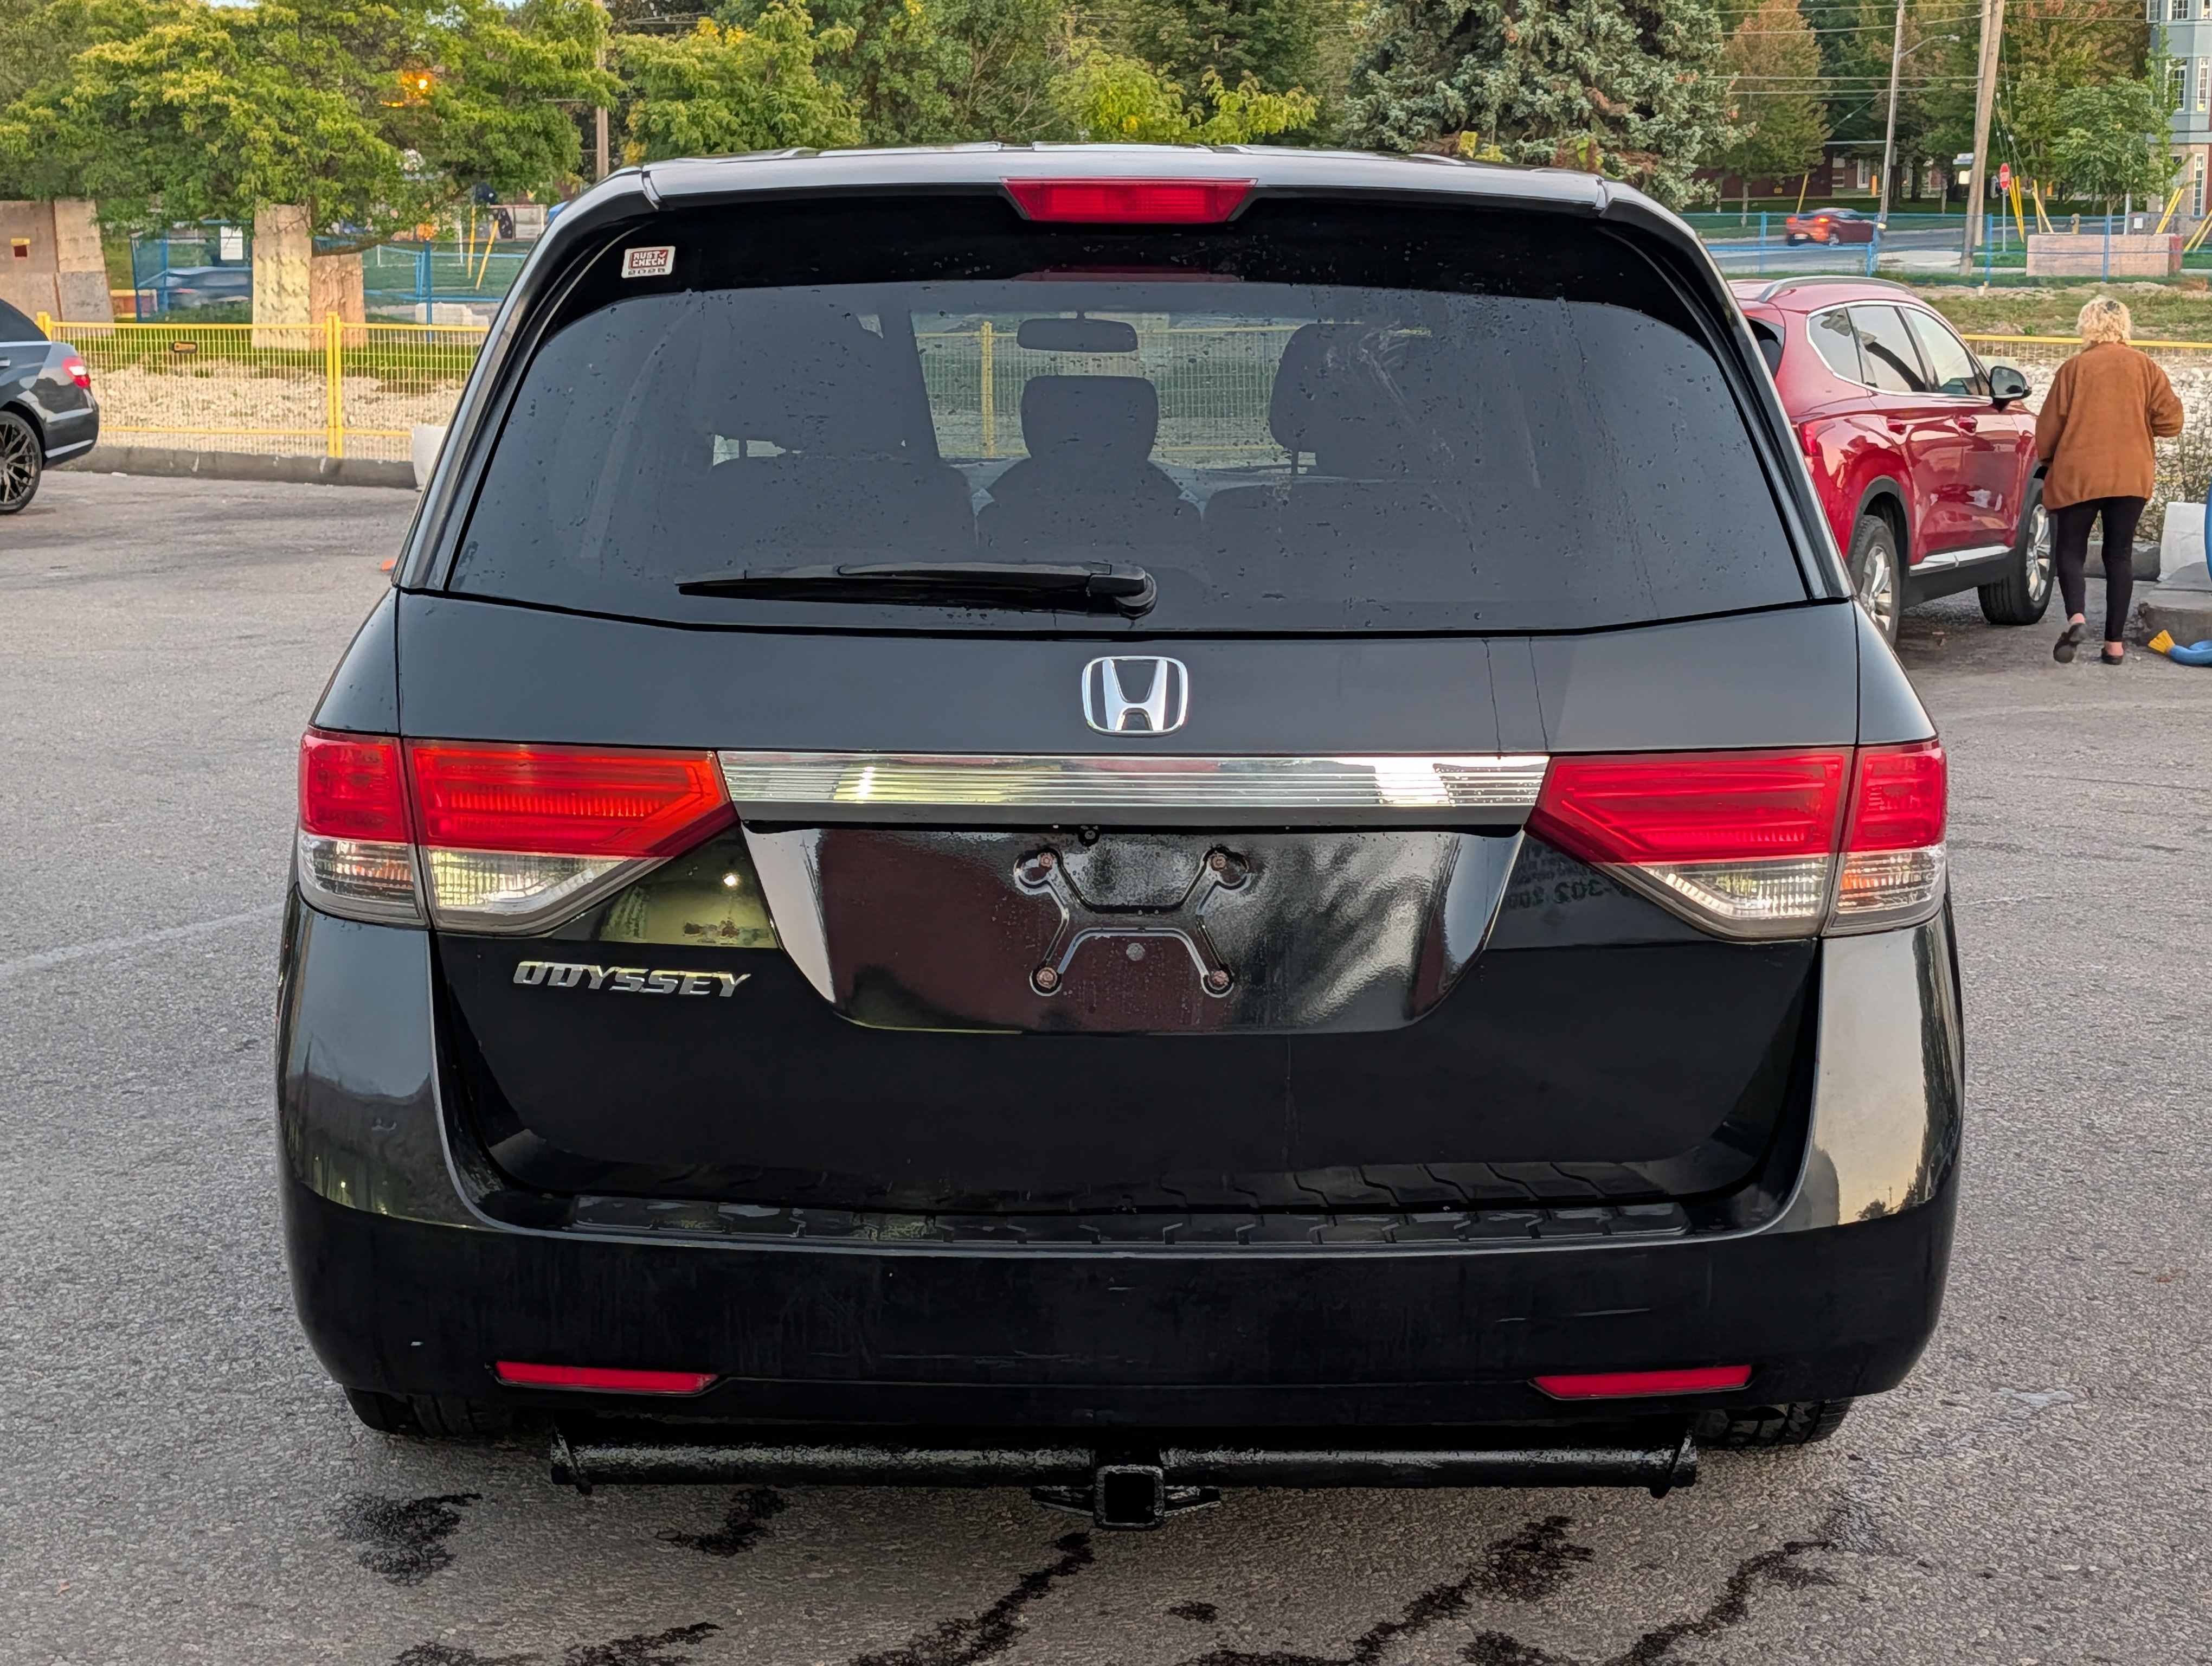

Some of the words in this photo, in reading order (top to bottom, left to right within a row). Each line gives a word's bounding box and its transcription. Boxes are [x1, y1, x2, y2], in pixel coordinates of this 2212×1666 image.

[633, 251, 660, 260] RUST
[632, 258, 665, 267] CHECK
[513, 960, 752, 997] ODYSSEY
